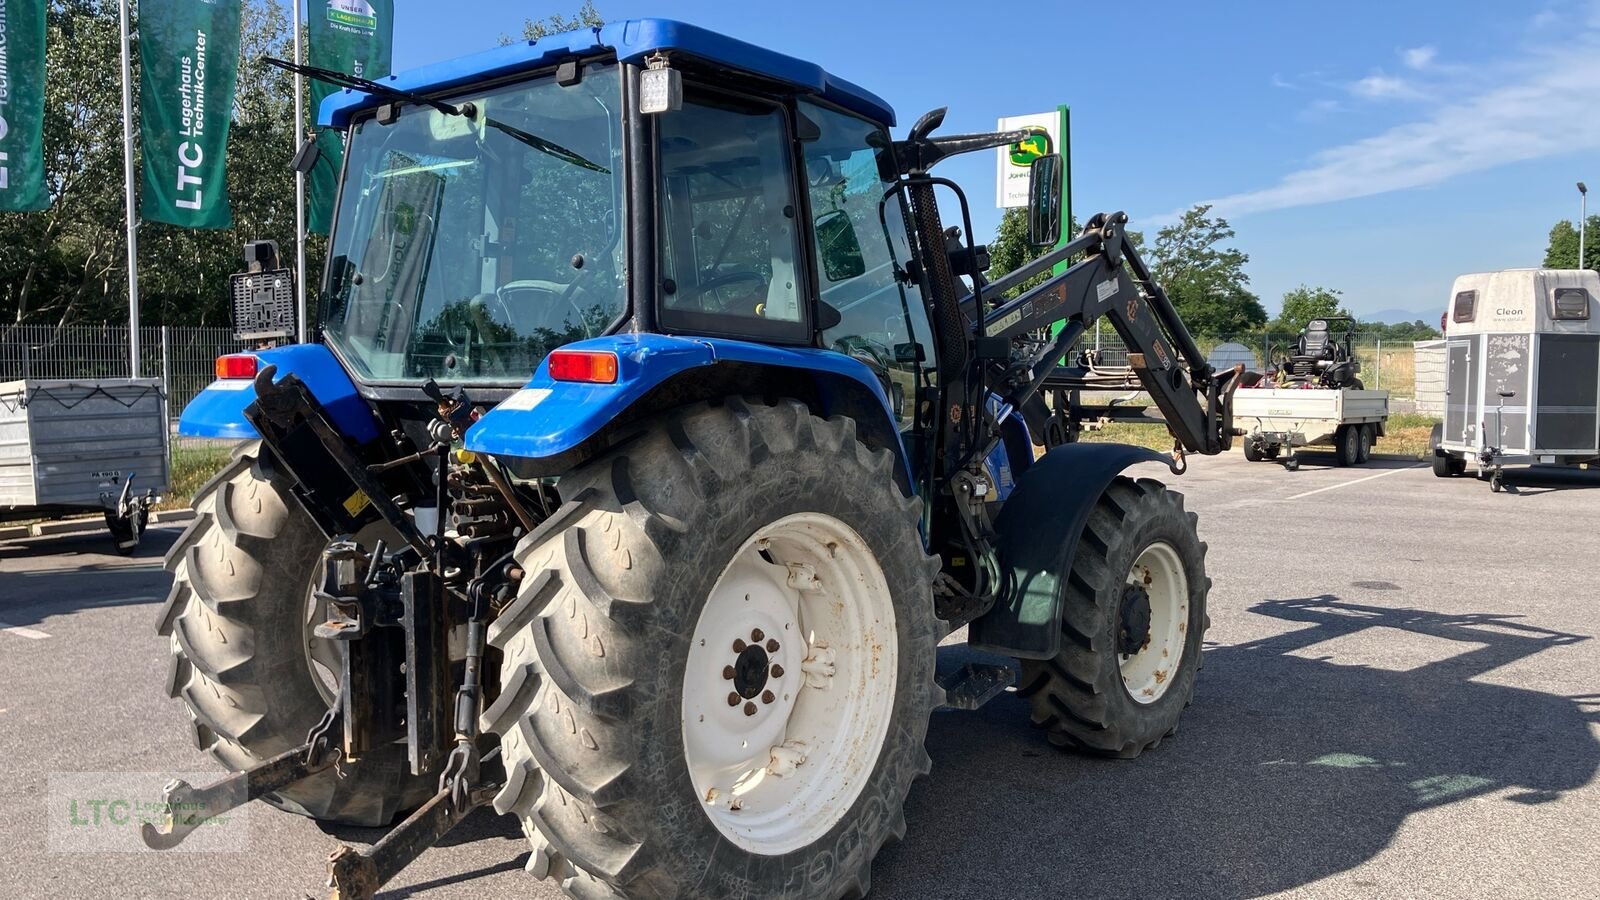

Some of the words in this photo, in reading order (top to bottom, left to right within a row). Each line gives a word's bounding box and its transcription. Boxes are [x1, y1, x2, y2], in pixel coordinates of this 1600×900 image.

[340, 4, 363, 13] UNSER
[339, 25, 351, 33] Kraft
[178, 56, 194, 136] Lagerhaus
[193, 30, 206, 138] TechnikCenter
[176, 142, 203, 210] LTC
[1496, 307, 1523, 316] Cleon
